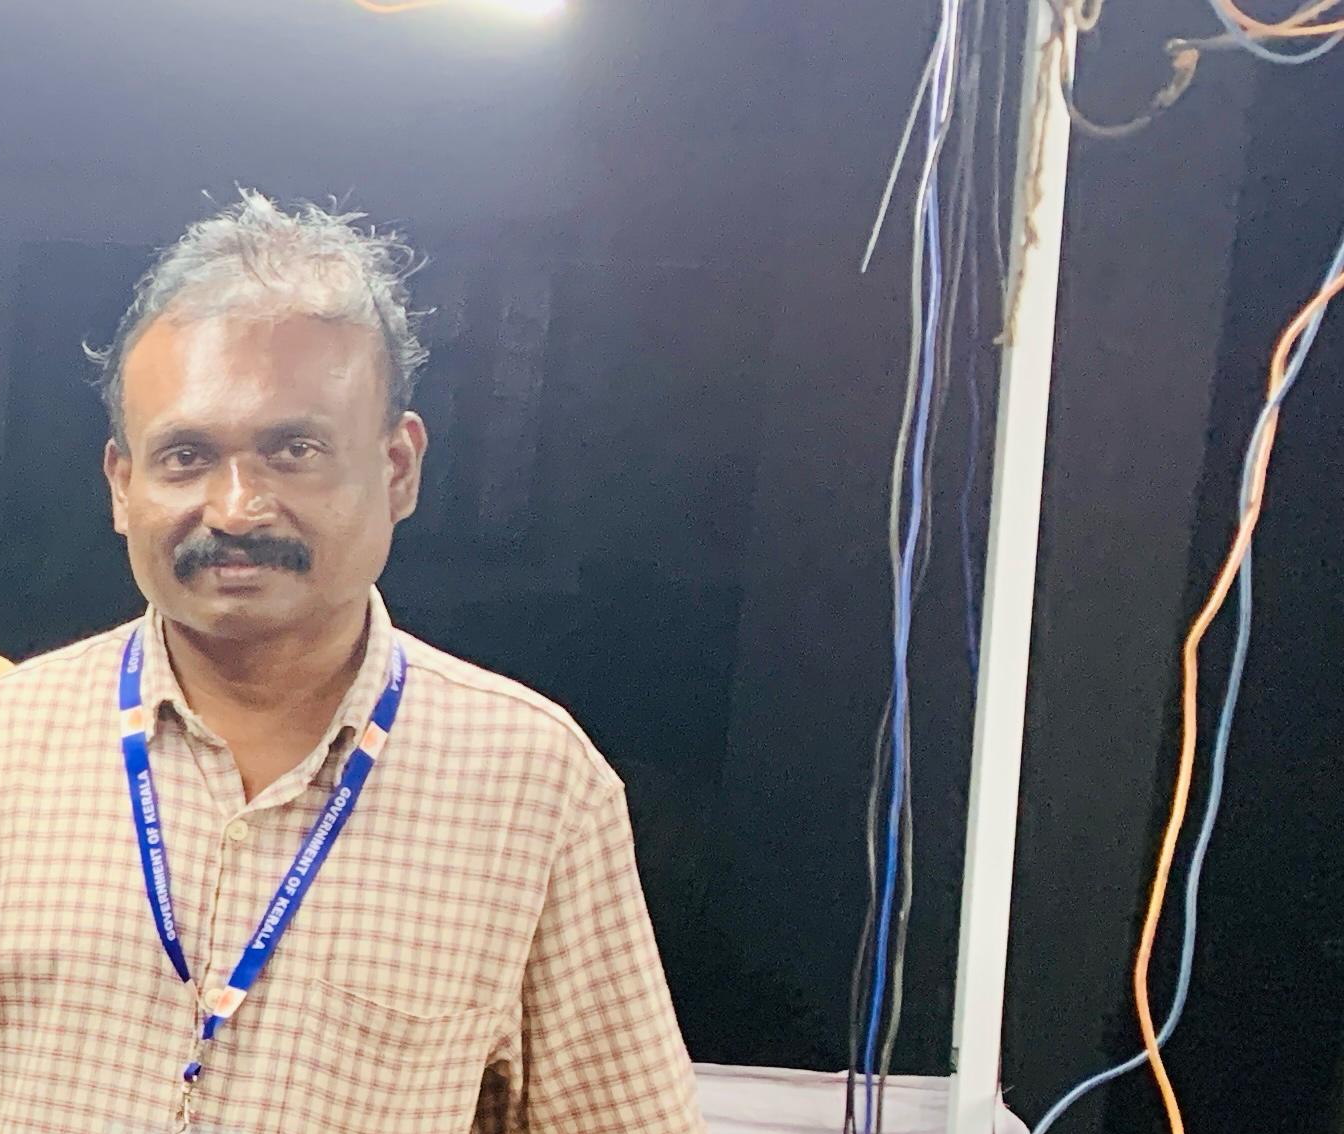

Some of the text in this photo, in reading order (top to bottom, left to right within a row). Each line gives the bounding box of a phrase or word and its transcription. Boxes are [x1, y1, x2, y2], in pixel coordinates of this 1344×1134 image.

[137, 769, 177, 941] GOVERNMENT OF KERALA
[251, 786, 351, 950] GOVERNMENT OF KERALA
